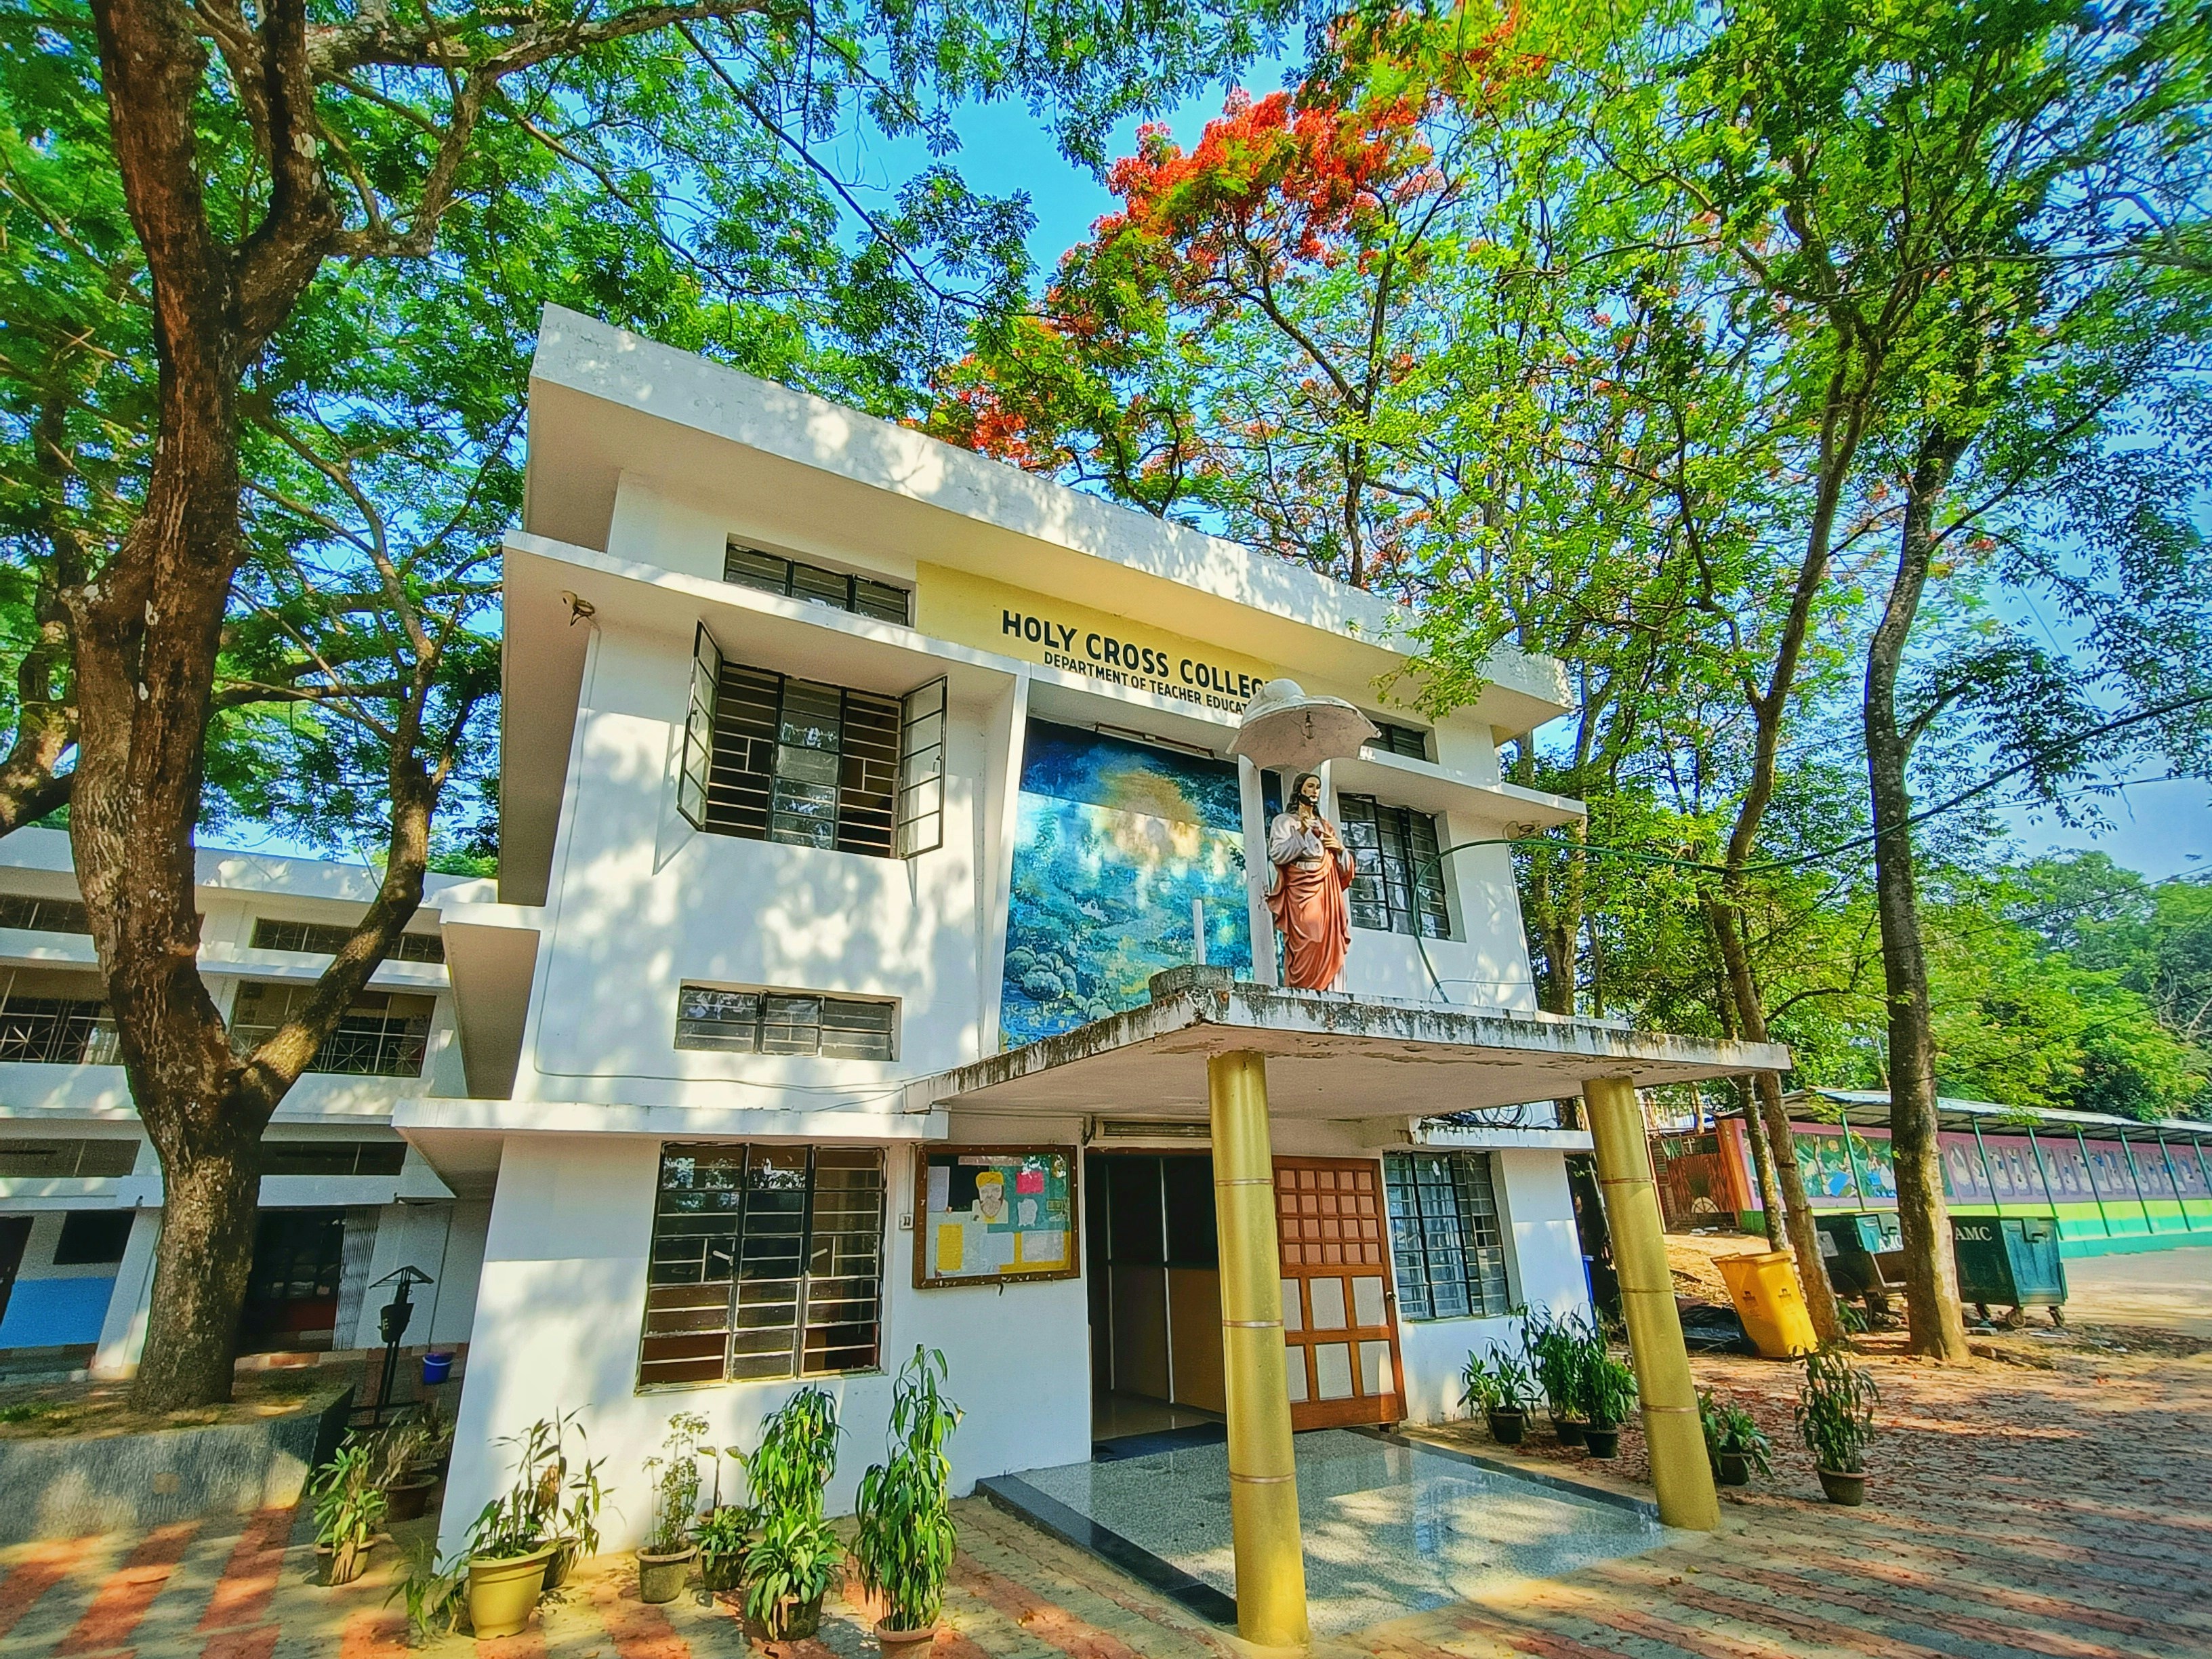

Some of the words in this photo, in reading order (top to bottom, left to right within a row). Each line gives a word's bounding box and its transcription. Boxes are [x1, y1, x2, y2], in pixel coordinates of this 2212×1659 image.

[1002, 609, 1078, 653] HOLY
[1086, 633, 1170, 678] CROSS
[1179, 659, 1271, 699] COLLEG
[1044, 651, 1128, 687] DEPARTMENT
[1130, 675, 1146, 690] OF
[1149, 679, 1202, 705] TEACHER
[1206, 693, 1252, 716] EDUCAT
[1954, 1226, 1992, 1242] AMC
